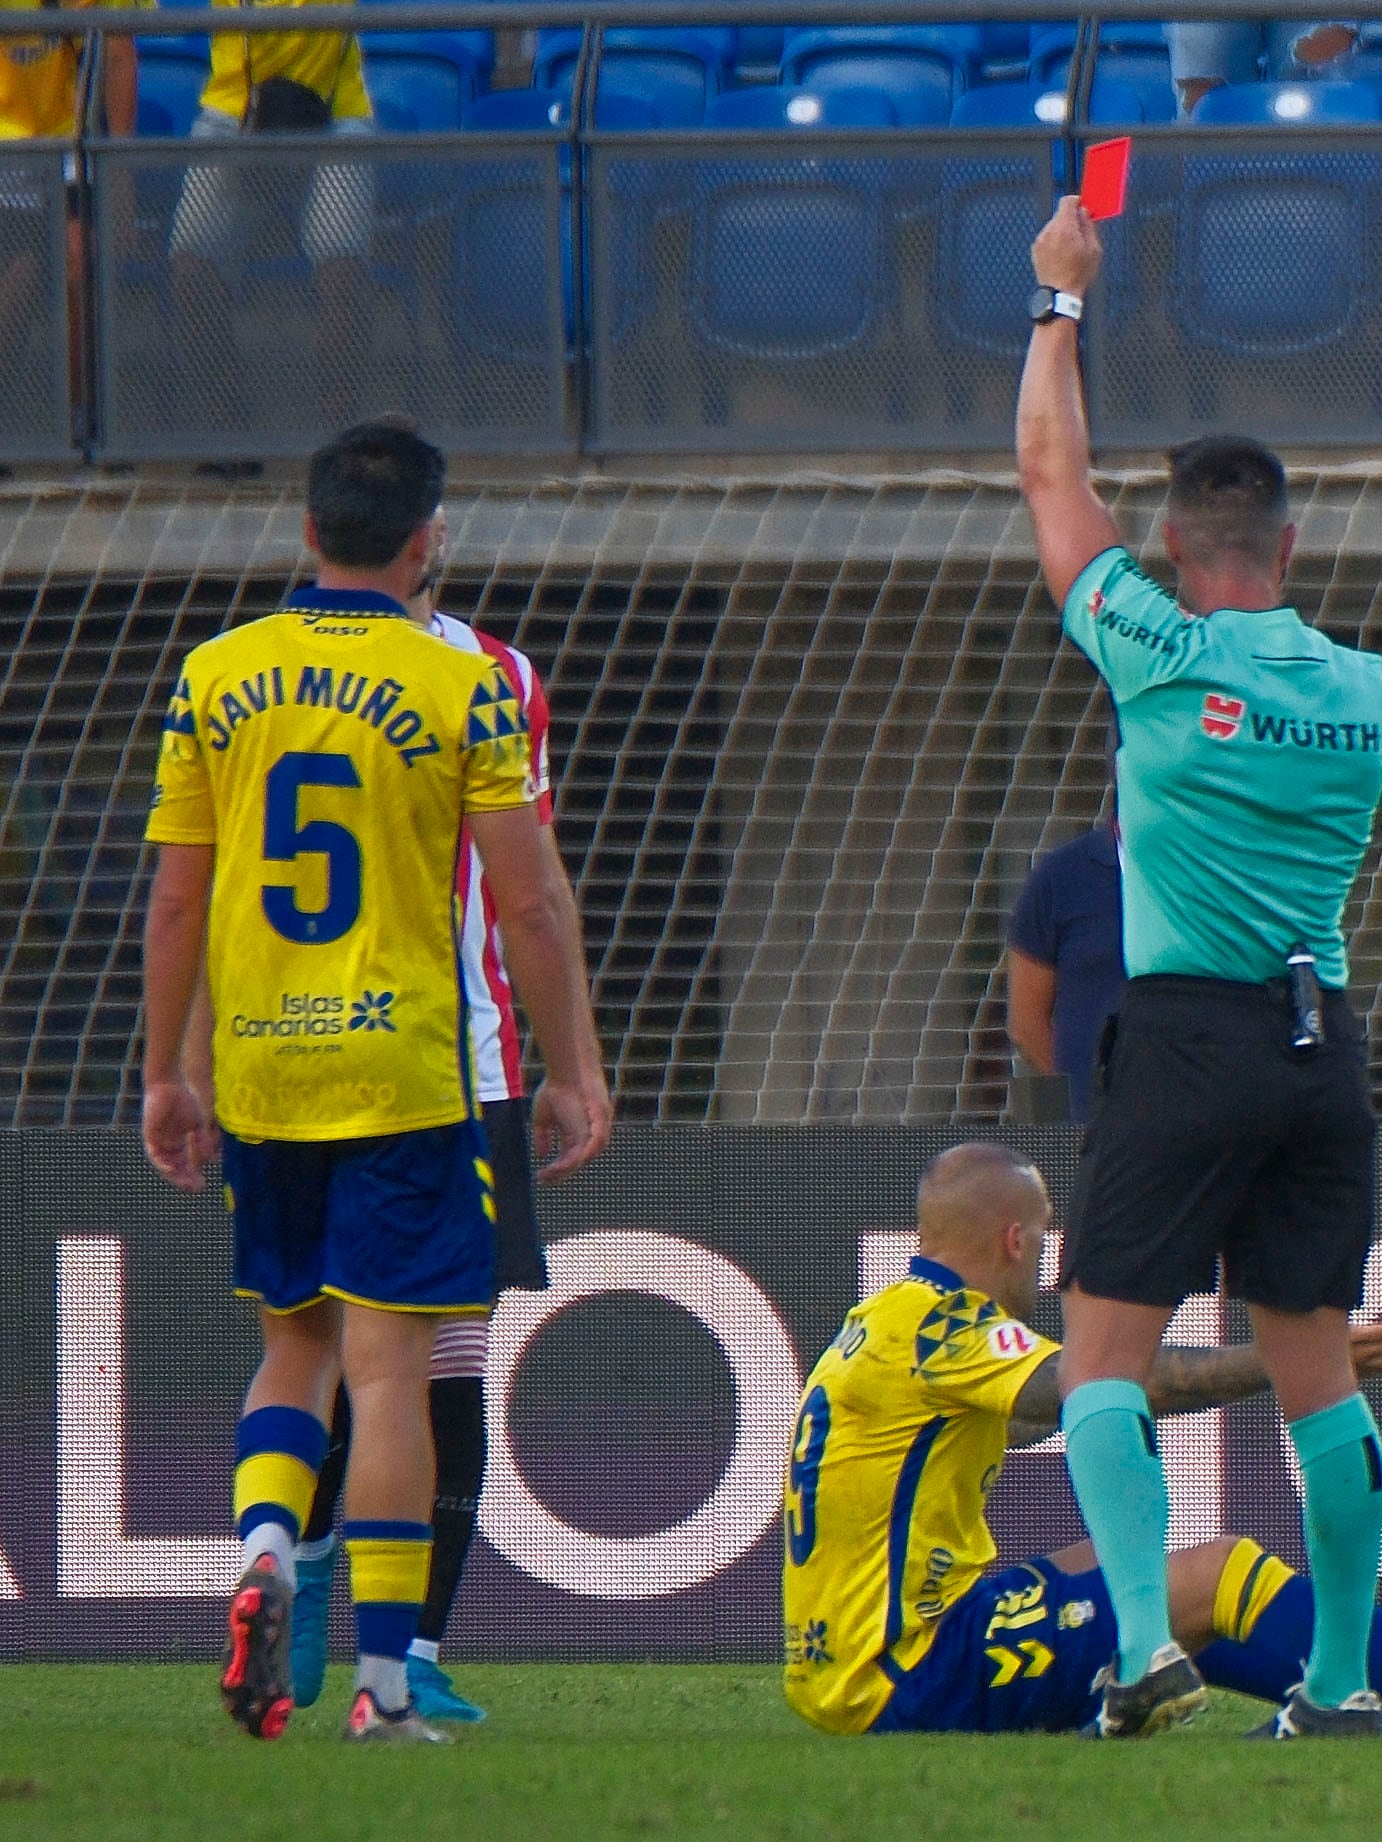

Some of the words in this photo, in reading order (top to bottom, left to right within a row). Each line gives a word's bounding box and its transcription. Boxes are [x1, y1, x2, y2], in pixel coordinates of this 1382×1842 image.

[206, 666, 283, 752] JAVI
[296, 666, 442, 770] MUÑOZ
[1251, 712, 1380, 752] WÜRTH
[261, 751, 363, 944] 5
[281, 992, 344, 1015] Islas
[231, 1013, 343, 1038] Canarias
